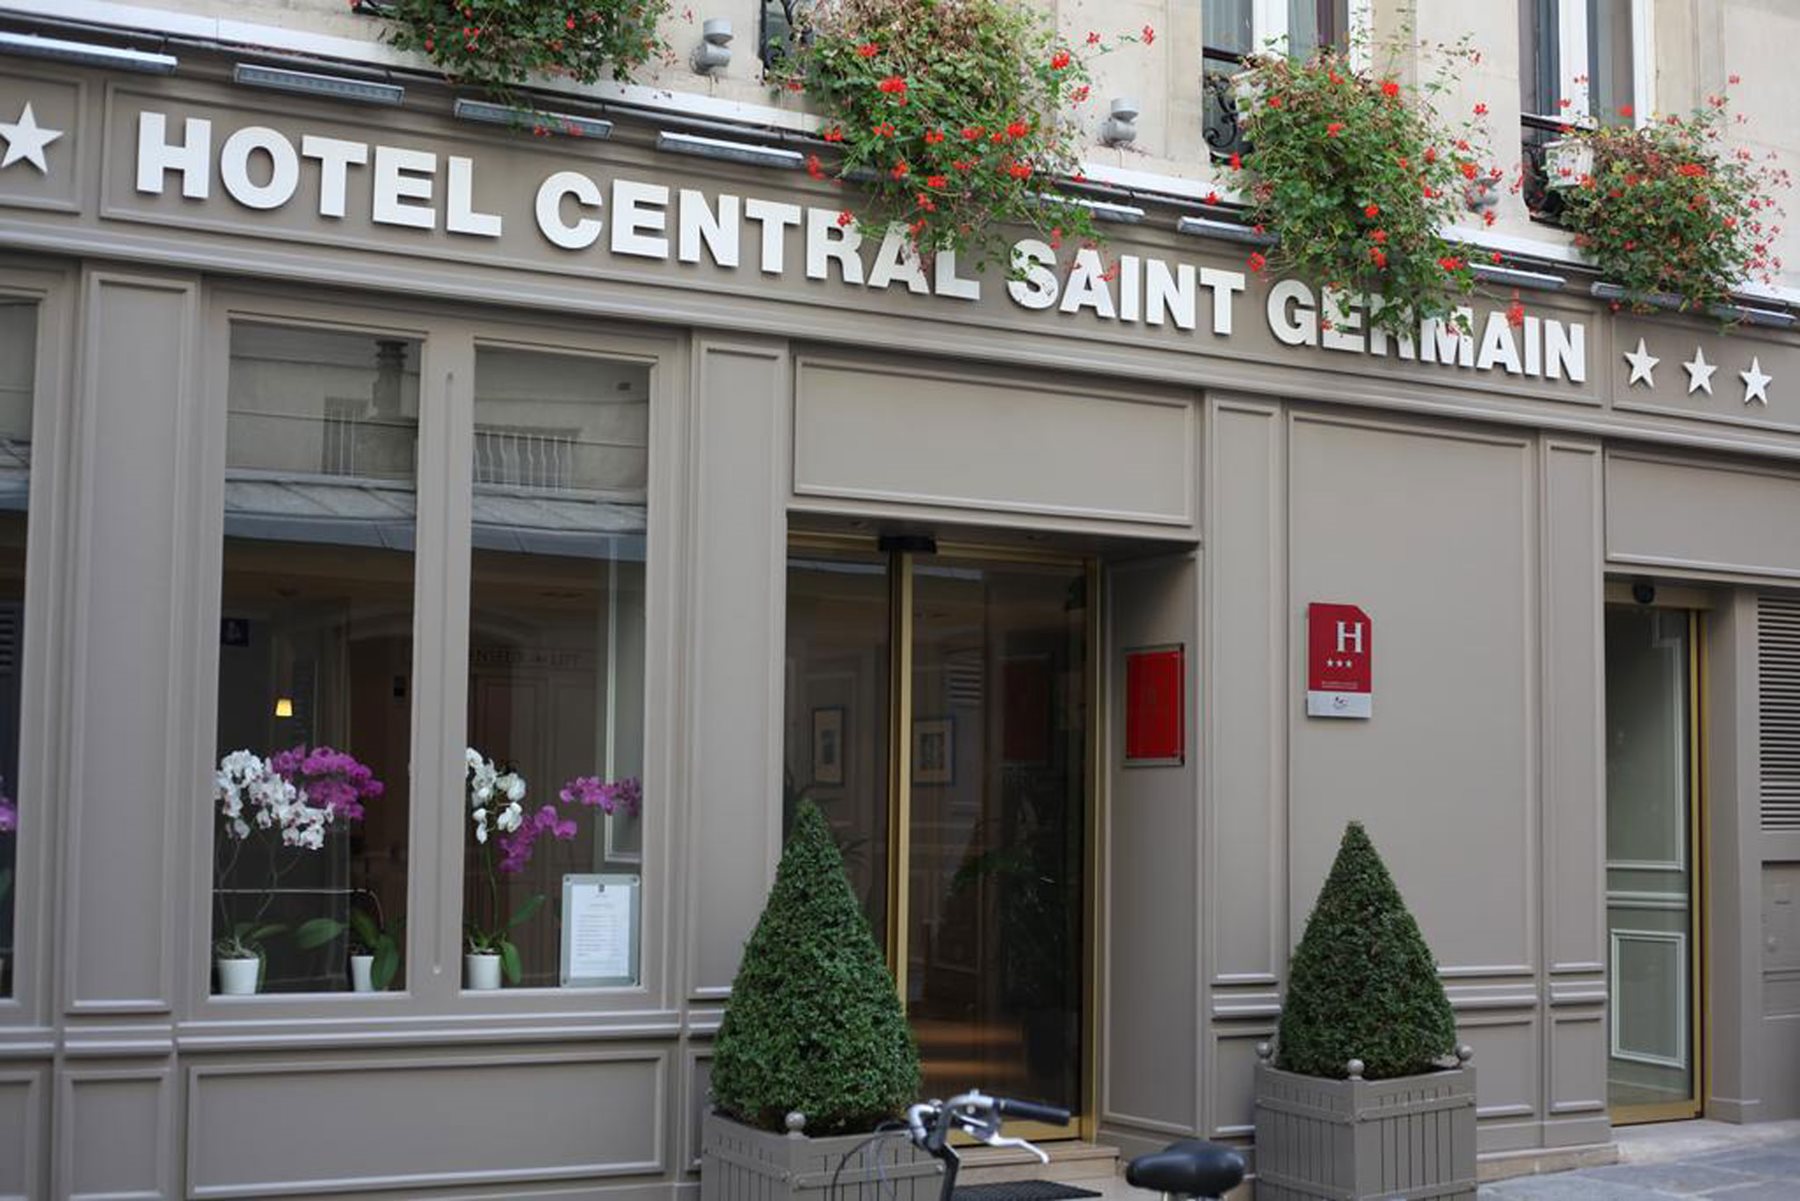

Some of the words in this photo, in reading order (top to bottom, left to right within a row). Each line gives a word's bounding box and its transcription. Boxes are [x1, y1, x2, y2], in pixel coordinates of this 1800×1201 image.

[136, 111, 502, 238] HOTEL
[535, 171, 981, 301] CENTRAL
[1007, 238, 1246, 336] SAINT
[1266, 279, 1587, 383] GERMAIN
[1336, 620, 1363, 653] H
